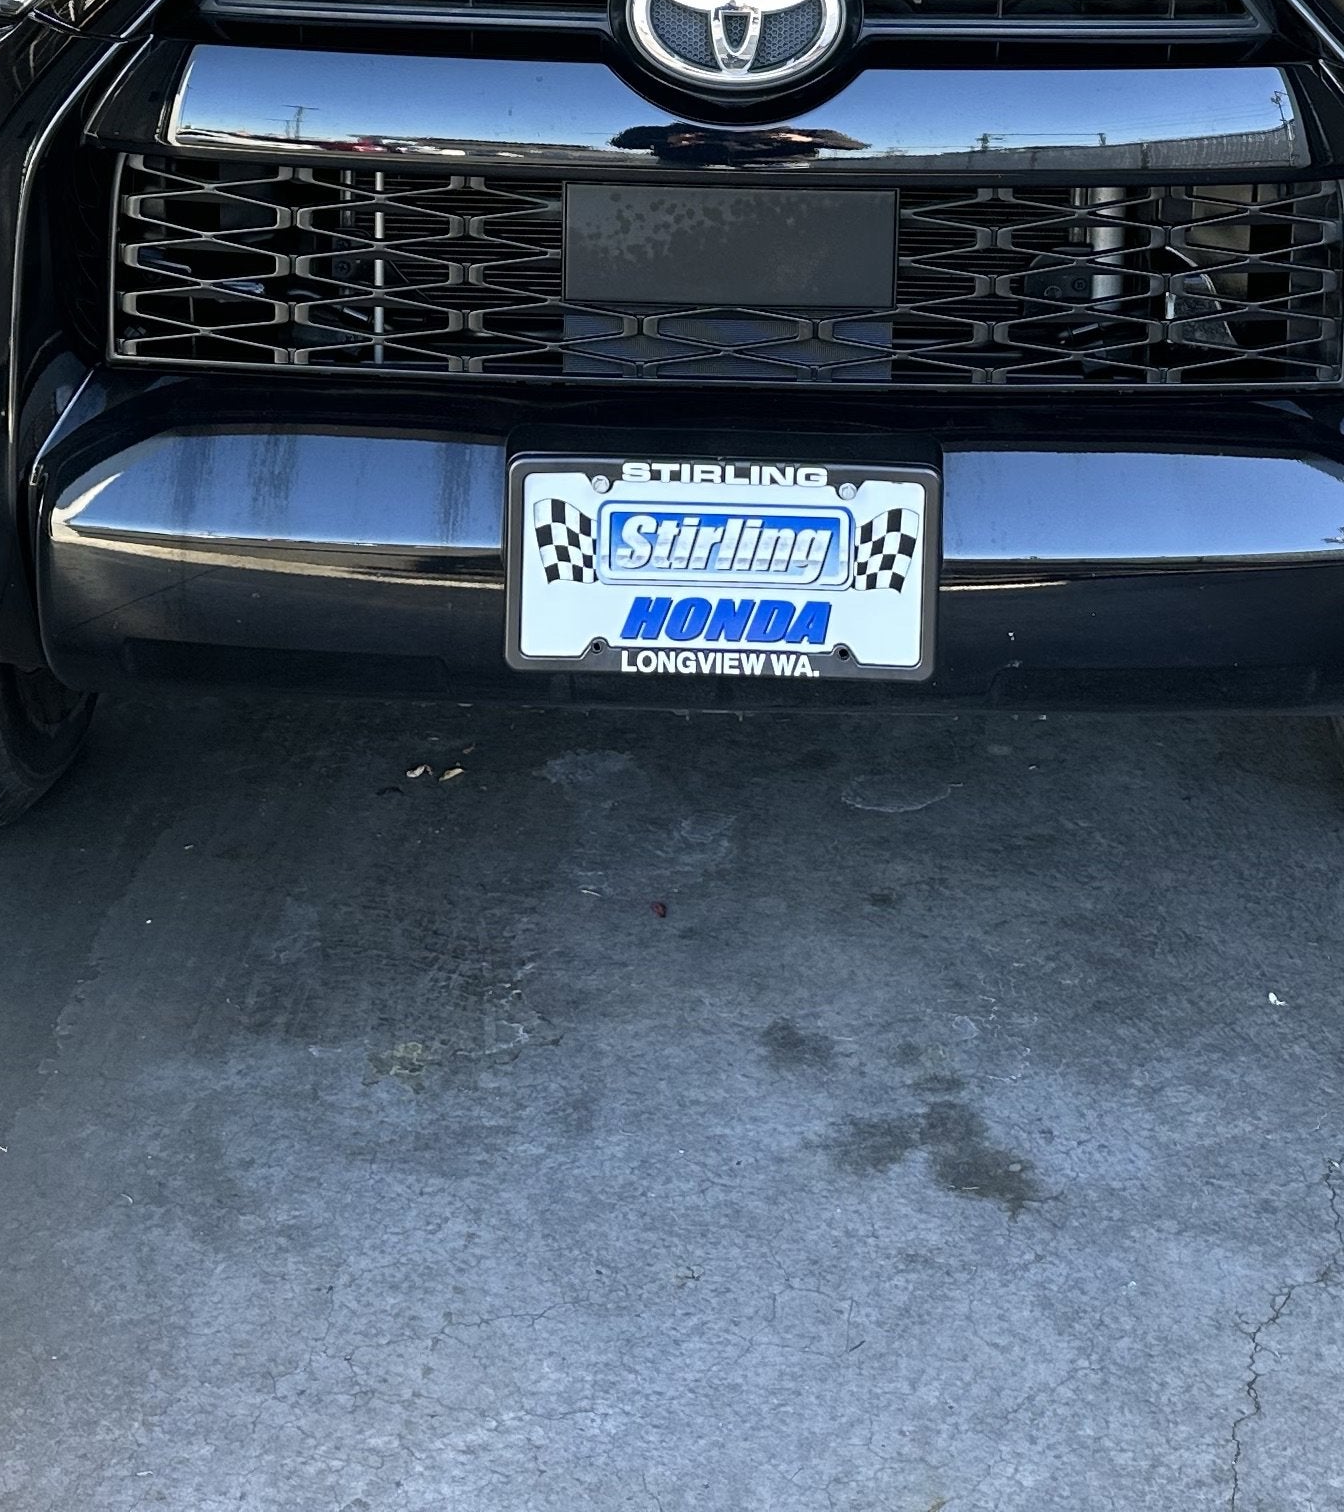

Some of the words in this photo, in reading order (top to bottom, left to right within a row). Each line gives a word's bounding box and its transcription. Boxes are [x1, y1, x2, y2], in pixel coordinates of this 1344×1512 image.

[621, 461, 829, 487] STIRLING
[616, 514, 833, 580] Stirling
[619, 596, 832, 645] HONDA
[620, 650, 766, 676] LONGVIEW
